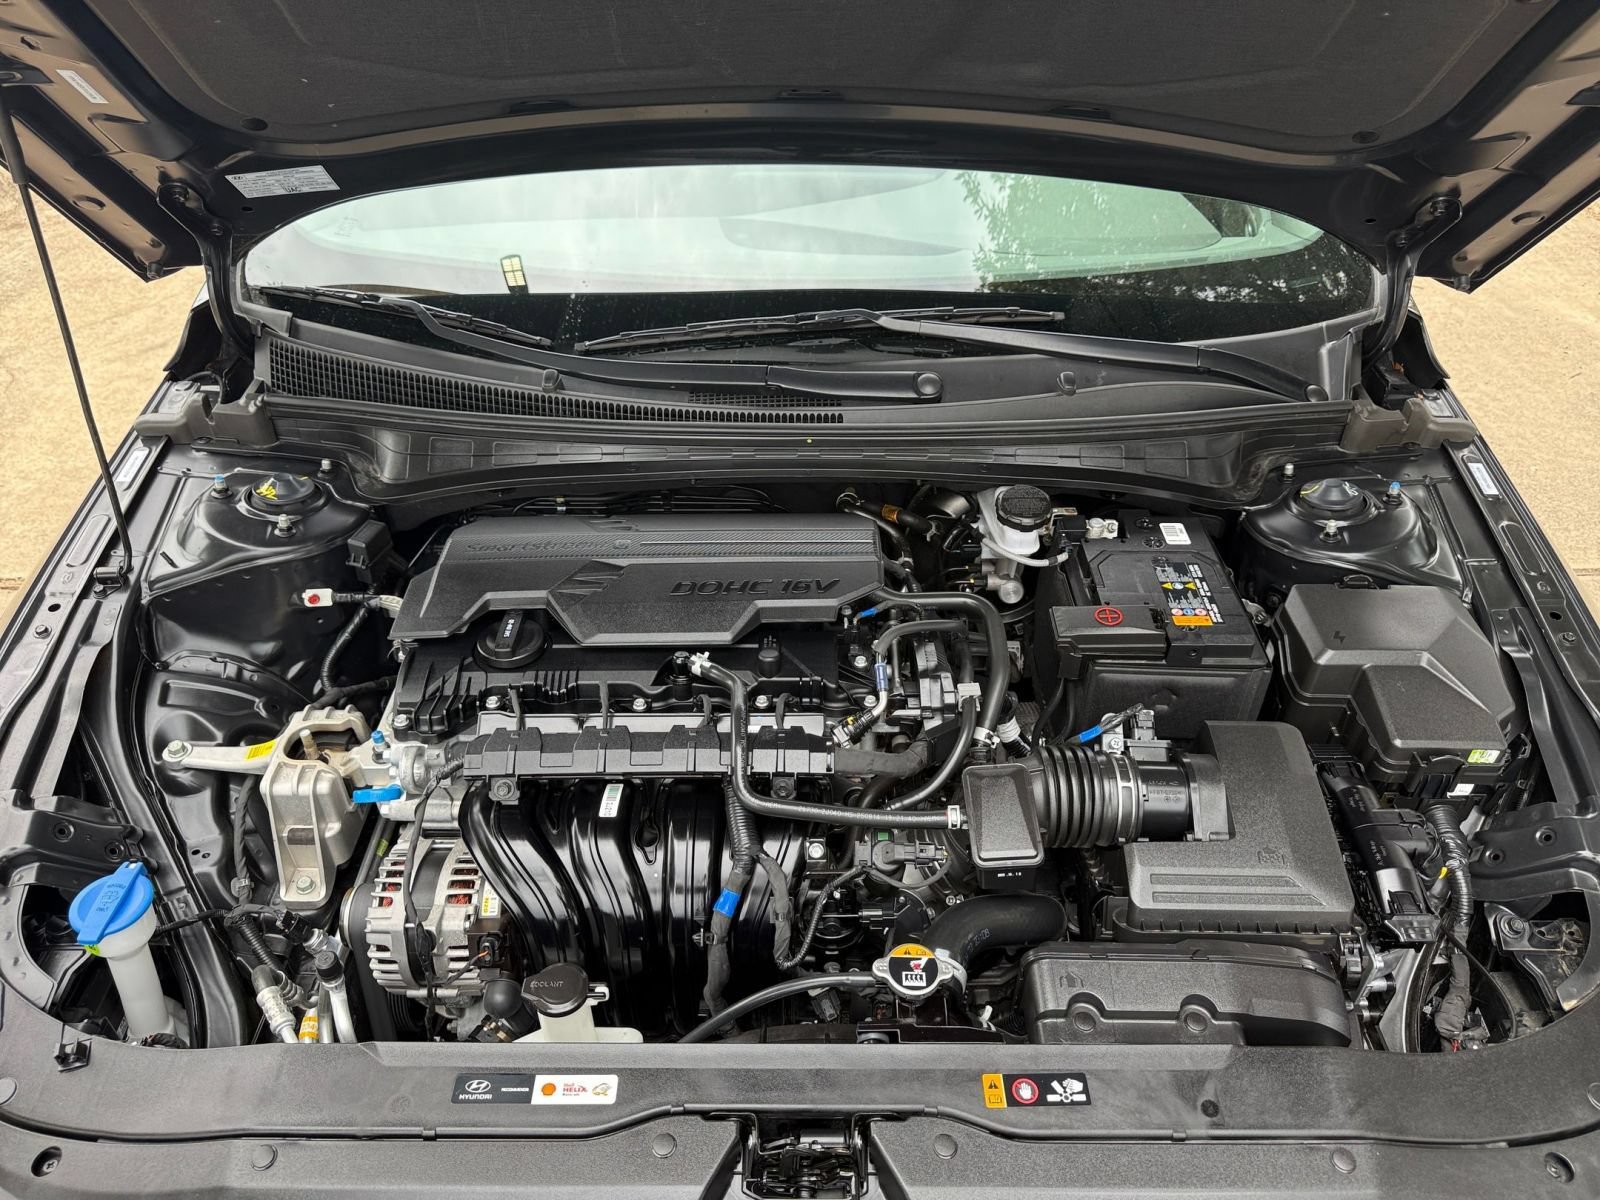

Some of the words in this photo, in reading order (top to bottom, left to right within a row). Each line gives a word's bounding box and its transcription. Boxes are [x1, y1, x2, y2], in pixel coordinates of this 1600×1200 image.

[669, 578, 774, 596] DOHC
[780, 578, 840, 595] 16V
[529, 980, 564, 988] COOLANT
